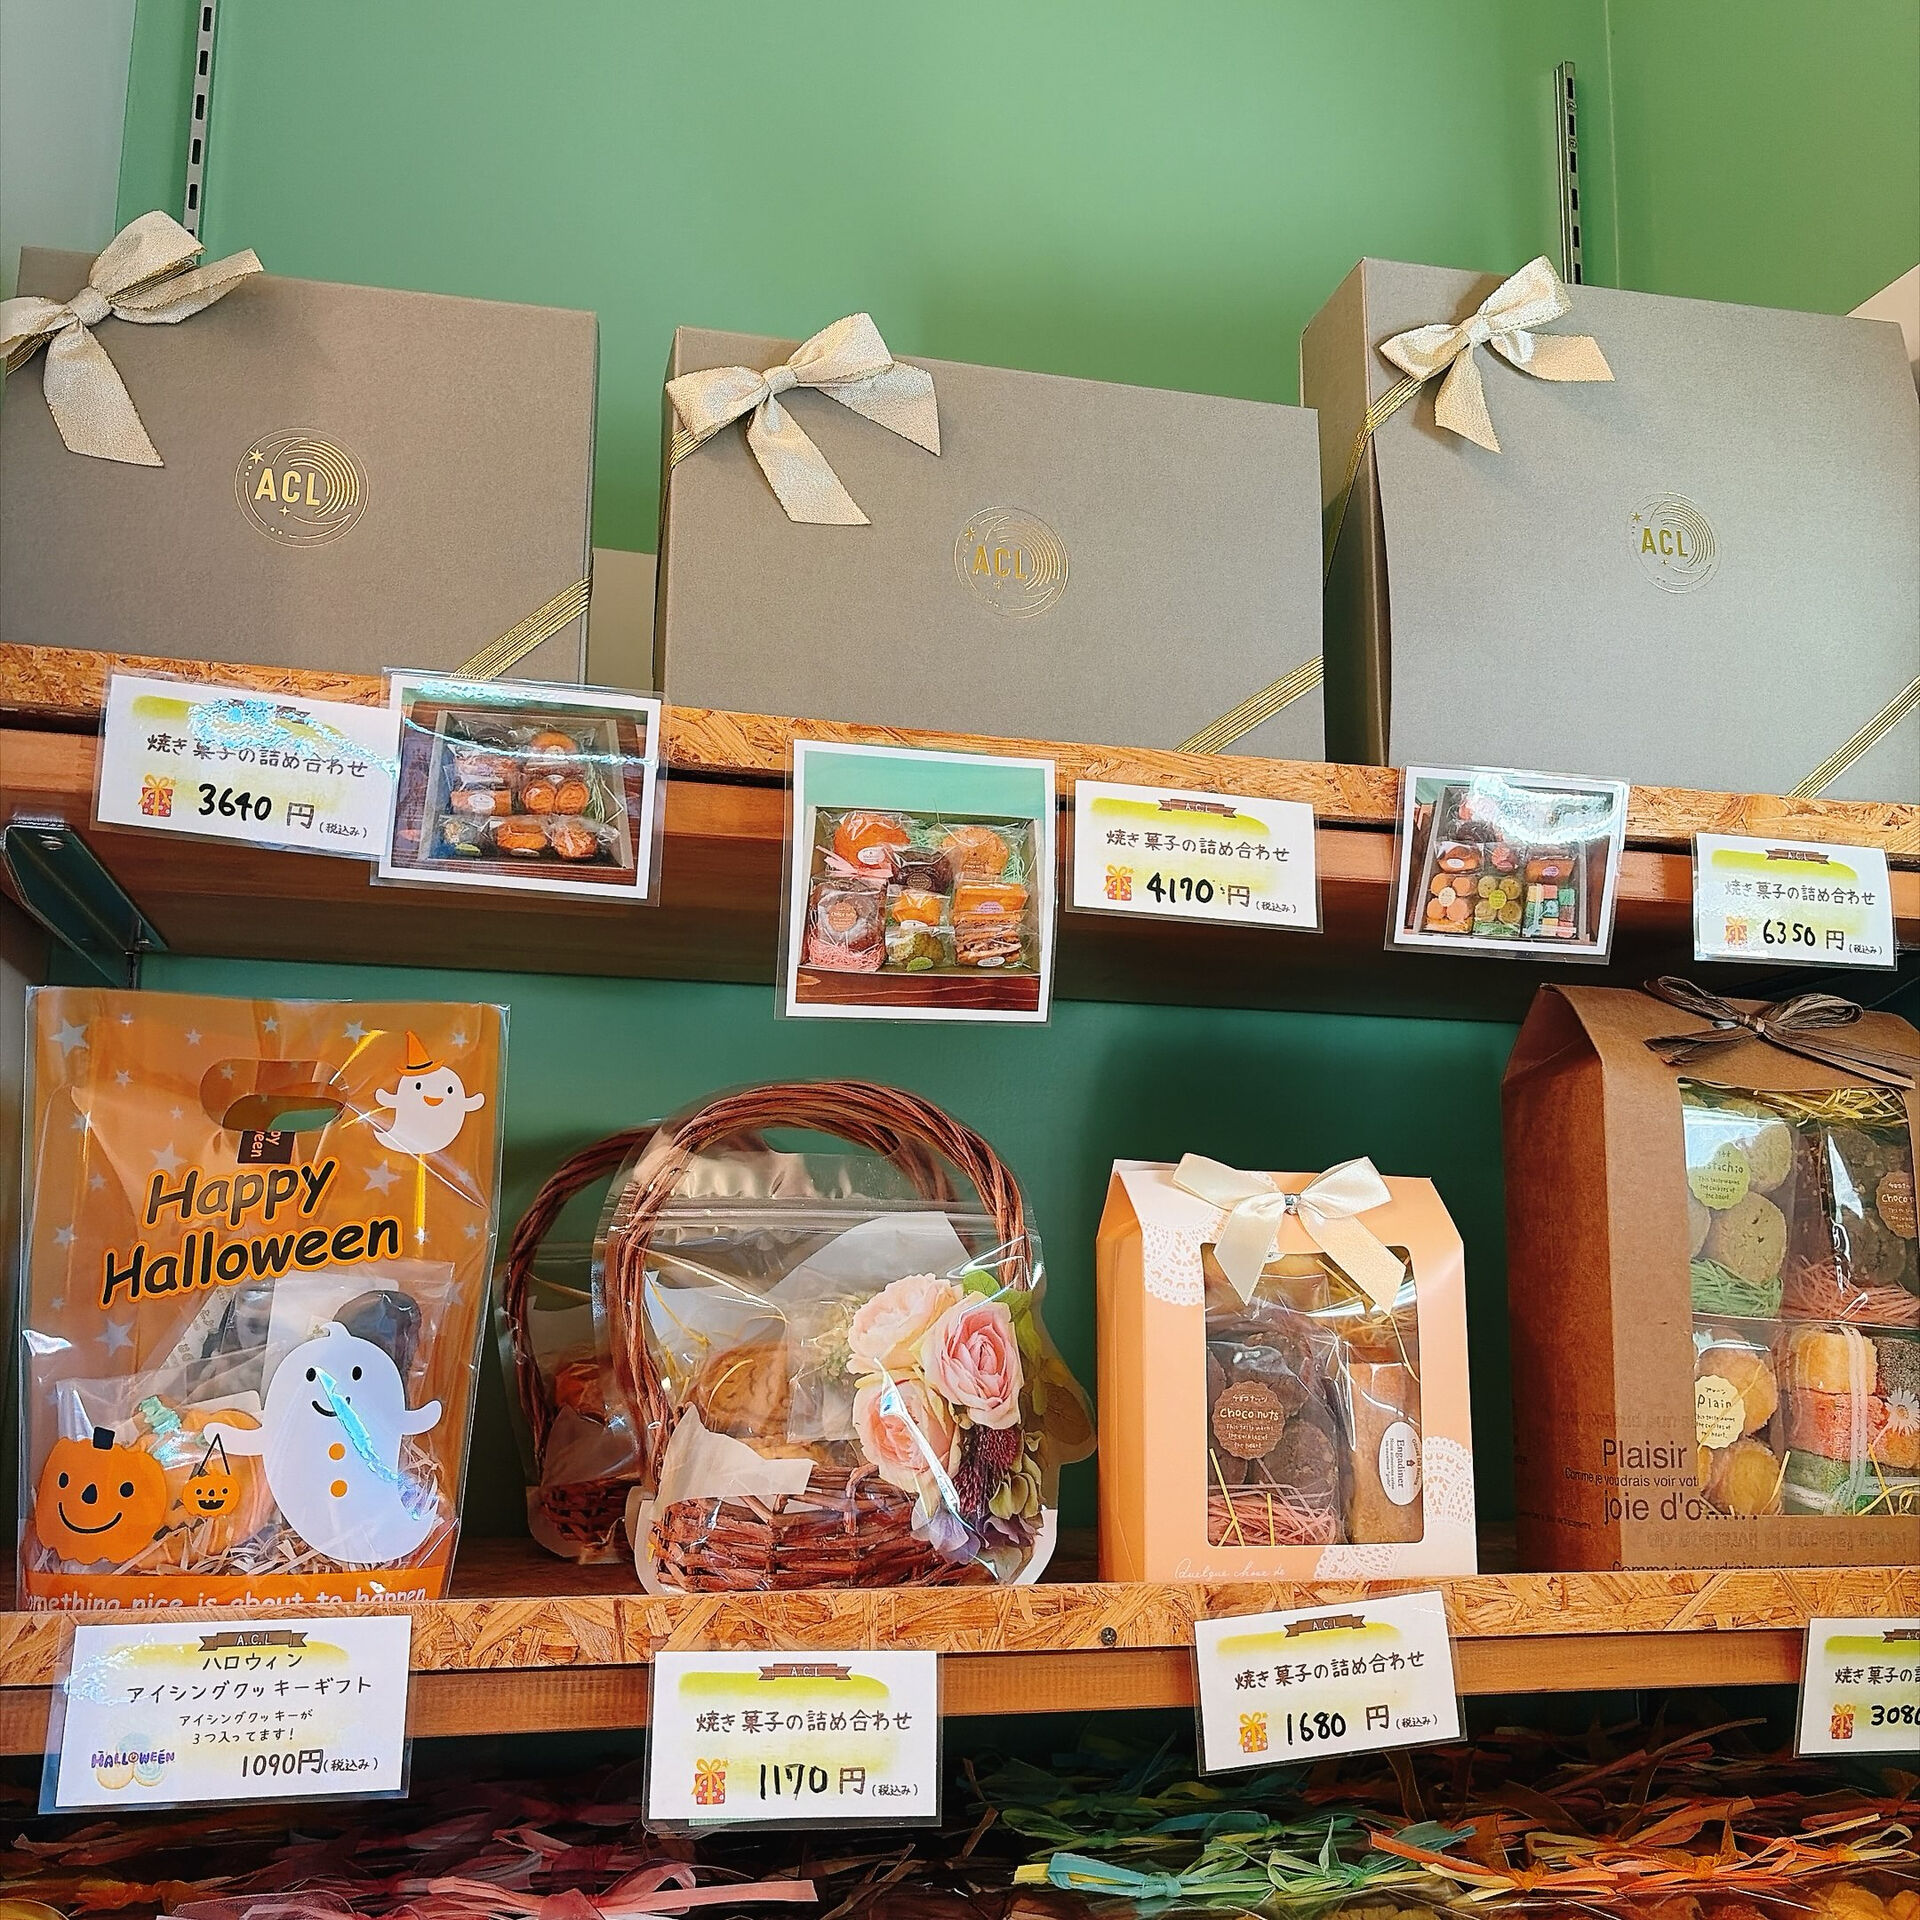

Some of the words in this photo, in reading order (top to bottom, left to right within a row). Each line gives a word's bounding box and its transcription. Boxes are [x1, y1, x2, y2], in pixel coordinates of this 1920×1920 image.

[254, 467, 321, 506] ACL
[1641, 525, 1688, 558] ACL
[973, 543, 1028, 580] ACL
[147, 732, 368, 778] 焼き菓子の詰め合わせ
[1106, 829, 1290, 862] 焼き菓子の詰め合わせ
[1724, 880, 1876, 906] 焼き菓子の詰め合わせ
[146, 1160, 336, 1226] Happy
[102, 1218, 400, 1305] Halloween
[1257, 1410, 1279, 1420] nuts
[1697, 1394, 1732, 1409] Plain
[1602, 1438, 1688, 1469] Plaisir
[1565, 1467, 1594, 1483] Comme
[1595, 1474, 1603, 1486] je
[1604, 1474, 1650, 1487] voudrais
[1653, 1475, 1676, 1487] voir
[1679, 1475, 1699, 1487] vot
[1603, 1490, 1649, 1525] joie
[132, 1593, 184, 1609] nice
[198, 1592, 218, 1607] is
[316, 1592, 342, 1605] to
[236, 1633, 272, 1647] A.C.L
[202, 1652, 303, 1672] ハロウィン
[1234, 1651, 1426, 1691] 焼き菓子の詰め合わせ
[126, 1675, 373, 1704] アイシングクッキーギフト
[179, 1708, 313, 1727] アイシングクッキーが
[695, 1709, 914, 1734] 焼き菓子の詰め合わせ
[1286, 1711, 1347, 1746] 1680
